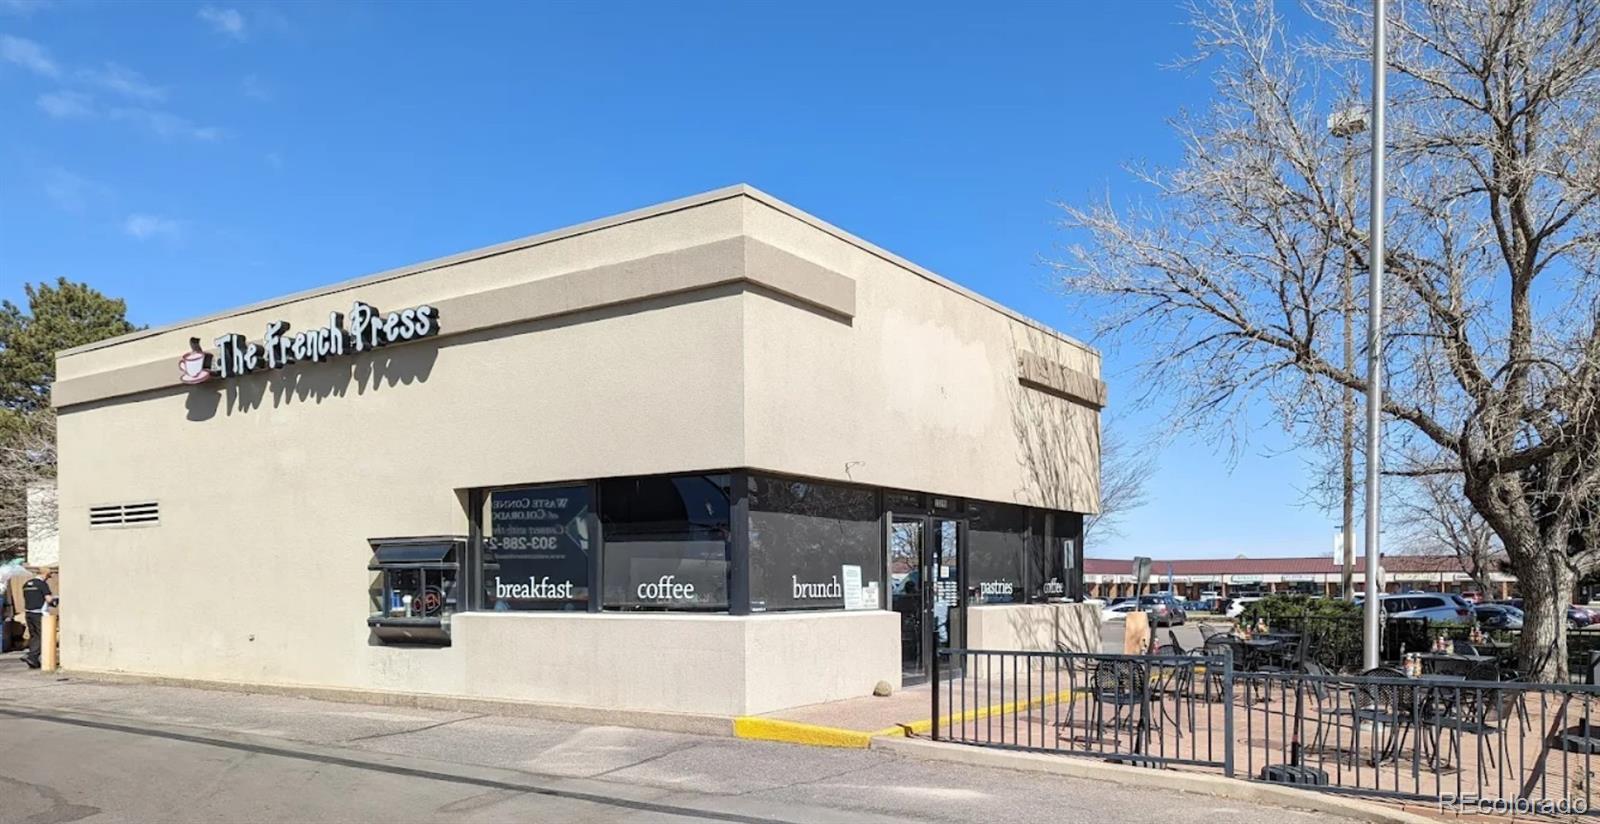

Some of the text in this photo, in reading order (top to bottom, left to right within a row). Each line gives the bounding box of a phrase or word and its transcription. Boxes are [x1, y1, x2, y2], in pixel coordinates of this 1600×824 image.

[214, 301, 433, 379] The French Press
[495, 576, 573, 599] breakfast
[637, 575, 695, 599] coffee
[792, 575, 842, 599] brunch
[980, 578, 1013, 600] pastries
[1043, 577, 1063, 594] coffee
